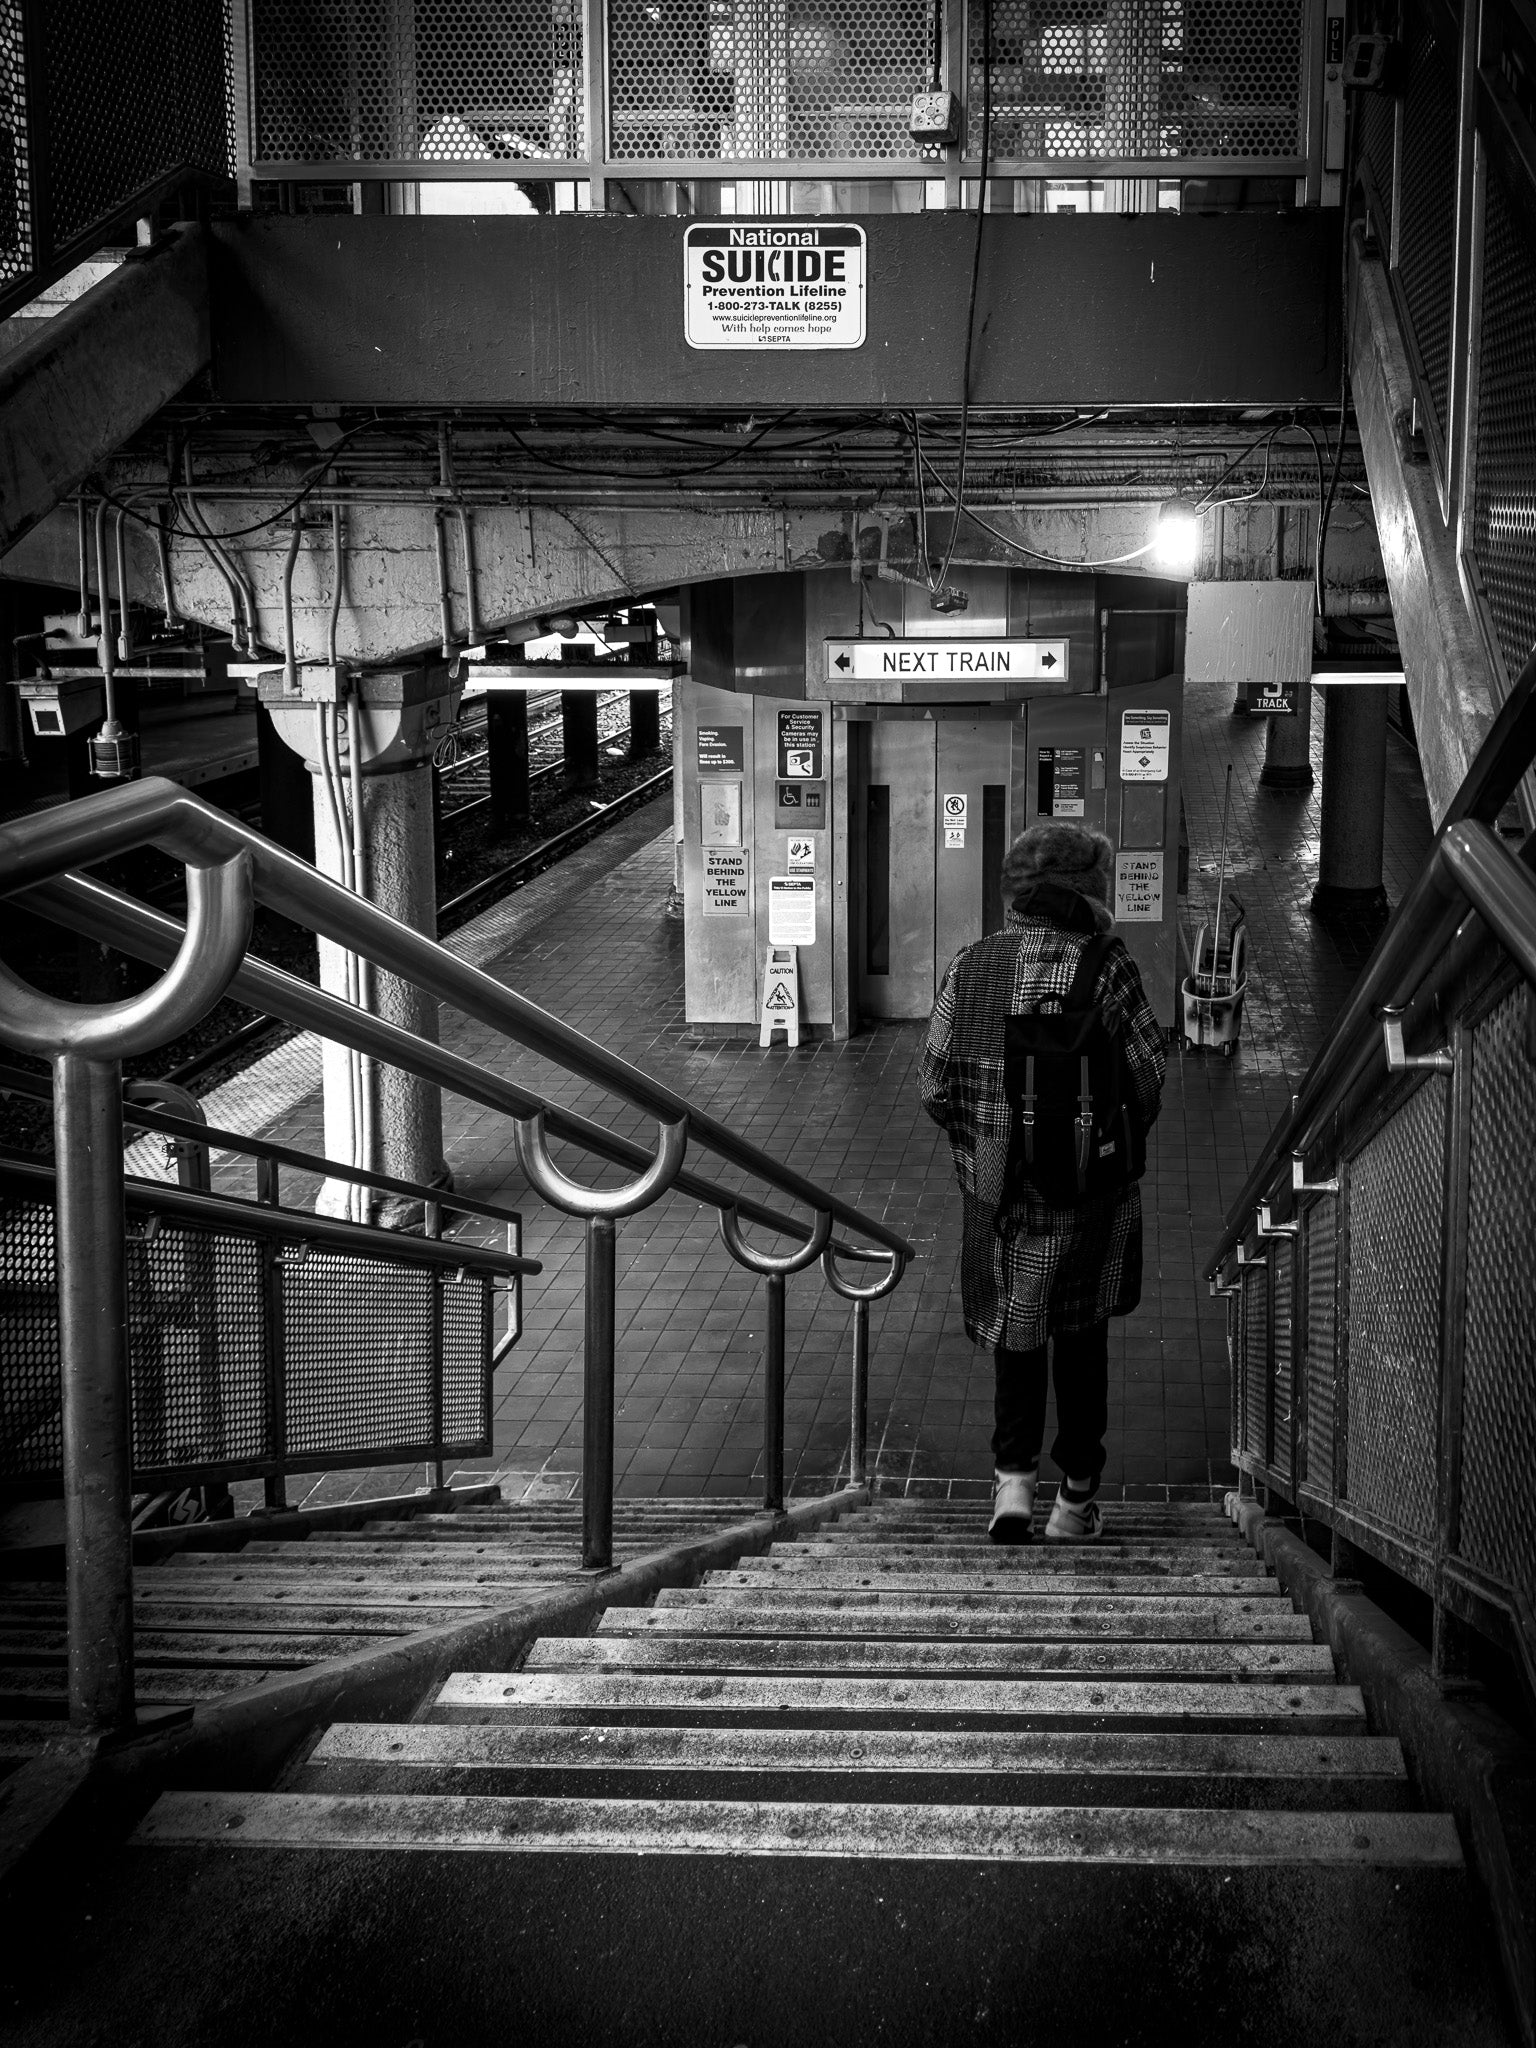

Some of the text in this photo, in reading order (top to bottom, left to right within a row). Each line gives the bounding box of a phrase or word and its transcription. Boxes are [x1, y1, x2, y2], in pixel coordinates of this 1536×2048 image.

[1331, 20, 1340, 62] PULL
[729, 228, 819, 246] National
[702, 286, 846, 296] Prevention Lifeline
[708, 302, 842, 312] 1-800-273-TALK (8255)
[712, 314, 837, 323] www.suicidepreventionlifeline.org
[722, 323, 832, 334] With help comes hope
[883, 651, 1010, 672] NEXT TRAIN
[1256, 698, 1288, 708] TRACK
[1129, 883, 1150, 891] THE
[1118, 893, 1160, 902] YELLOW
